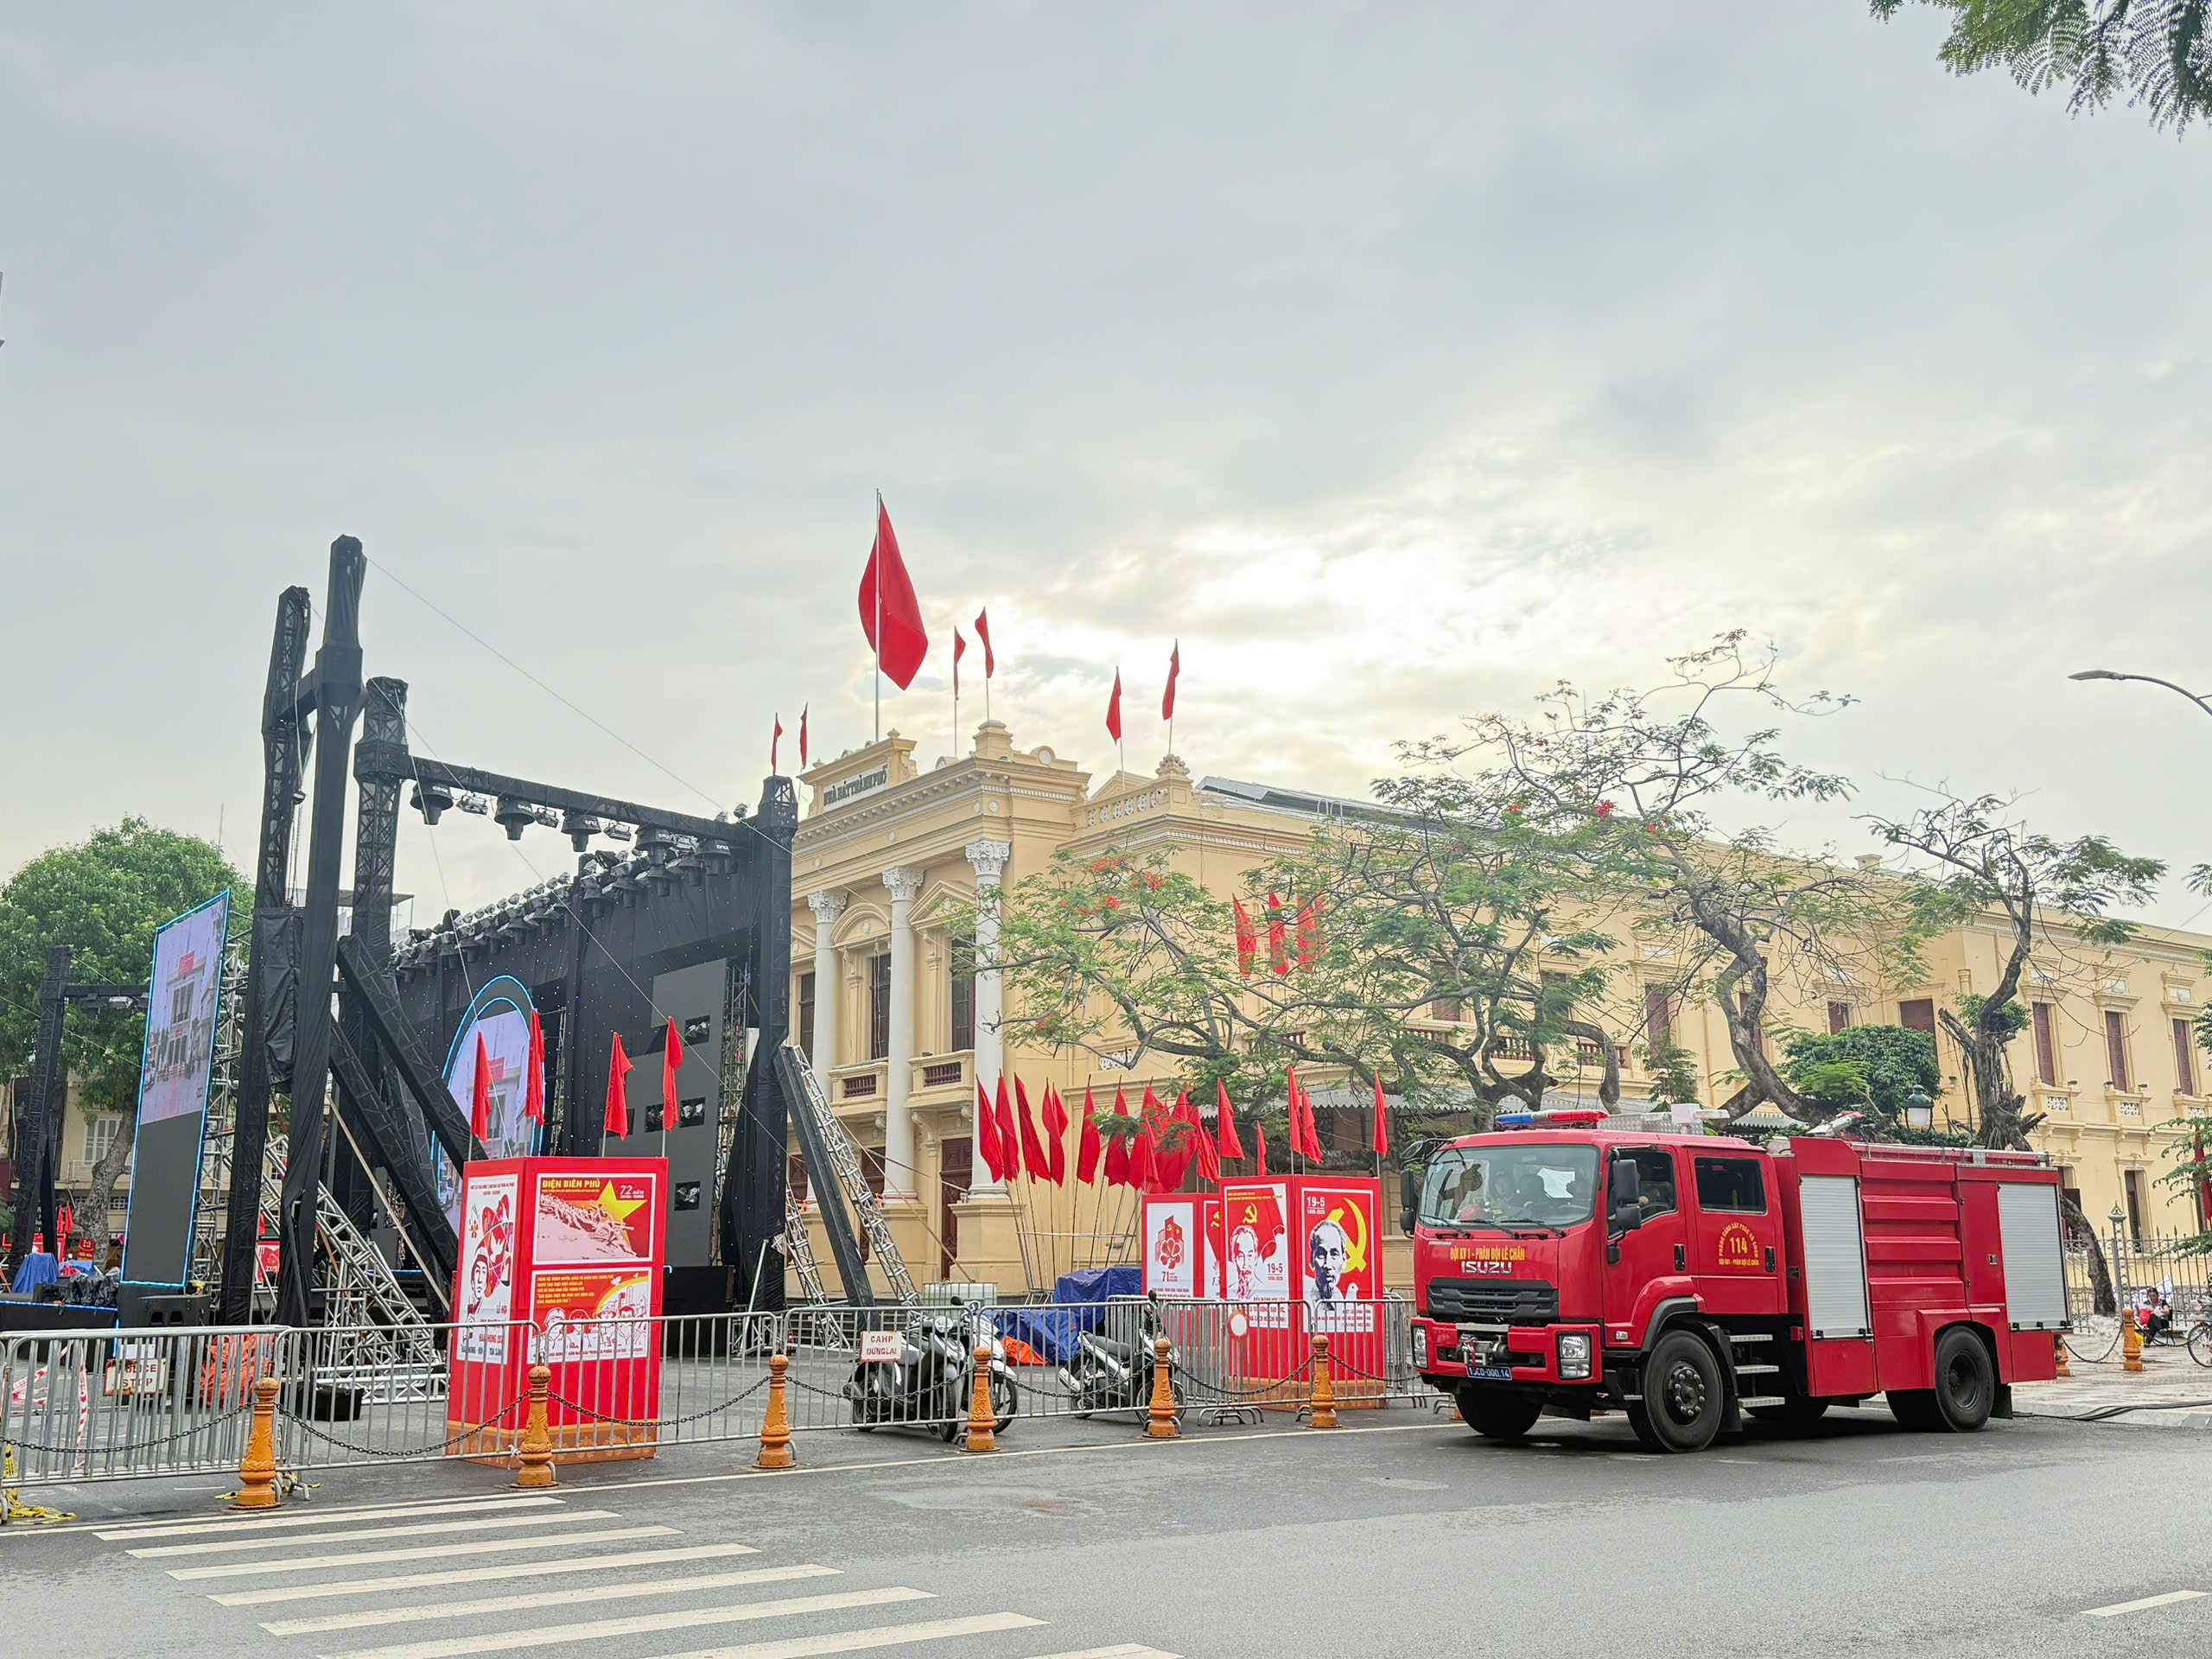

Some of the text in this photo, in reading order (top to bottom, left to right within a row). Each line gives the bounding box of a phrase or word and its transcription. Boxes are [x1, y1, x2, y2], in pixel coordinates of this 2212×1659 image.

[563, 1179, 582, 1188] BIÊN
[584, 1178, 601, 1188] PHỦ
[620, 1185, 632, 1195] 72
[1306, 1196, 1325, 1207] 19-5
[1730, 1236, 1748, 1254] 114
[1267, 1262, 1283, 1274] 19-5
[1461, 1261, 1512, 1274] ISUZU
[1161, 1271, 1169, 1282] 71
[870, 1335, 893, 1344] CAHP
